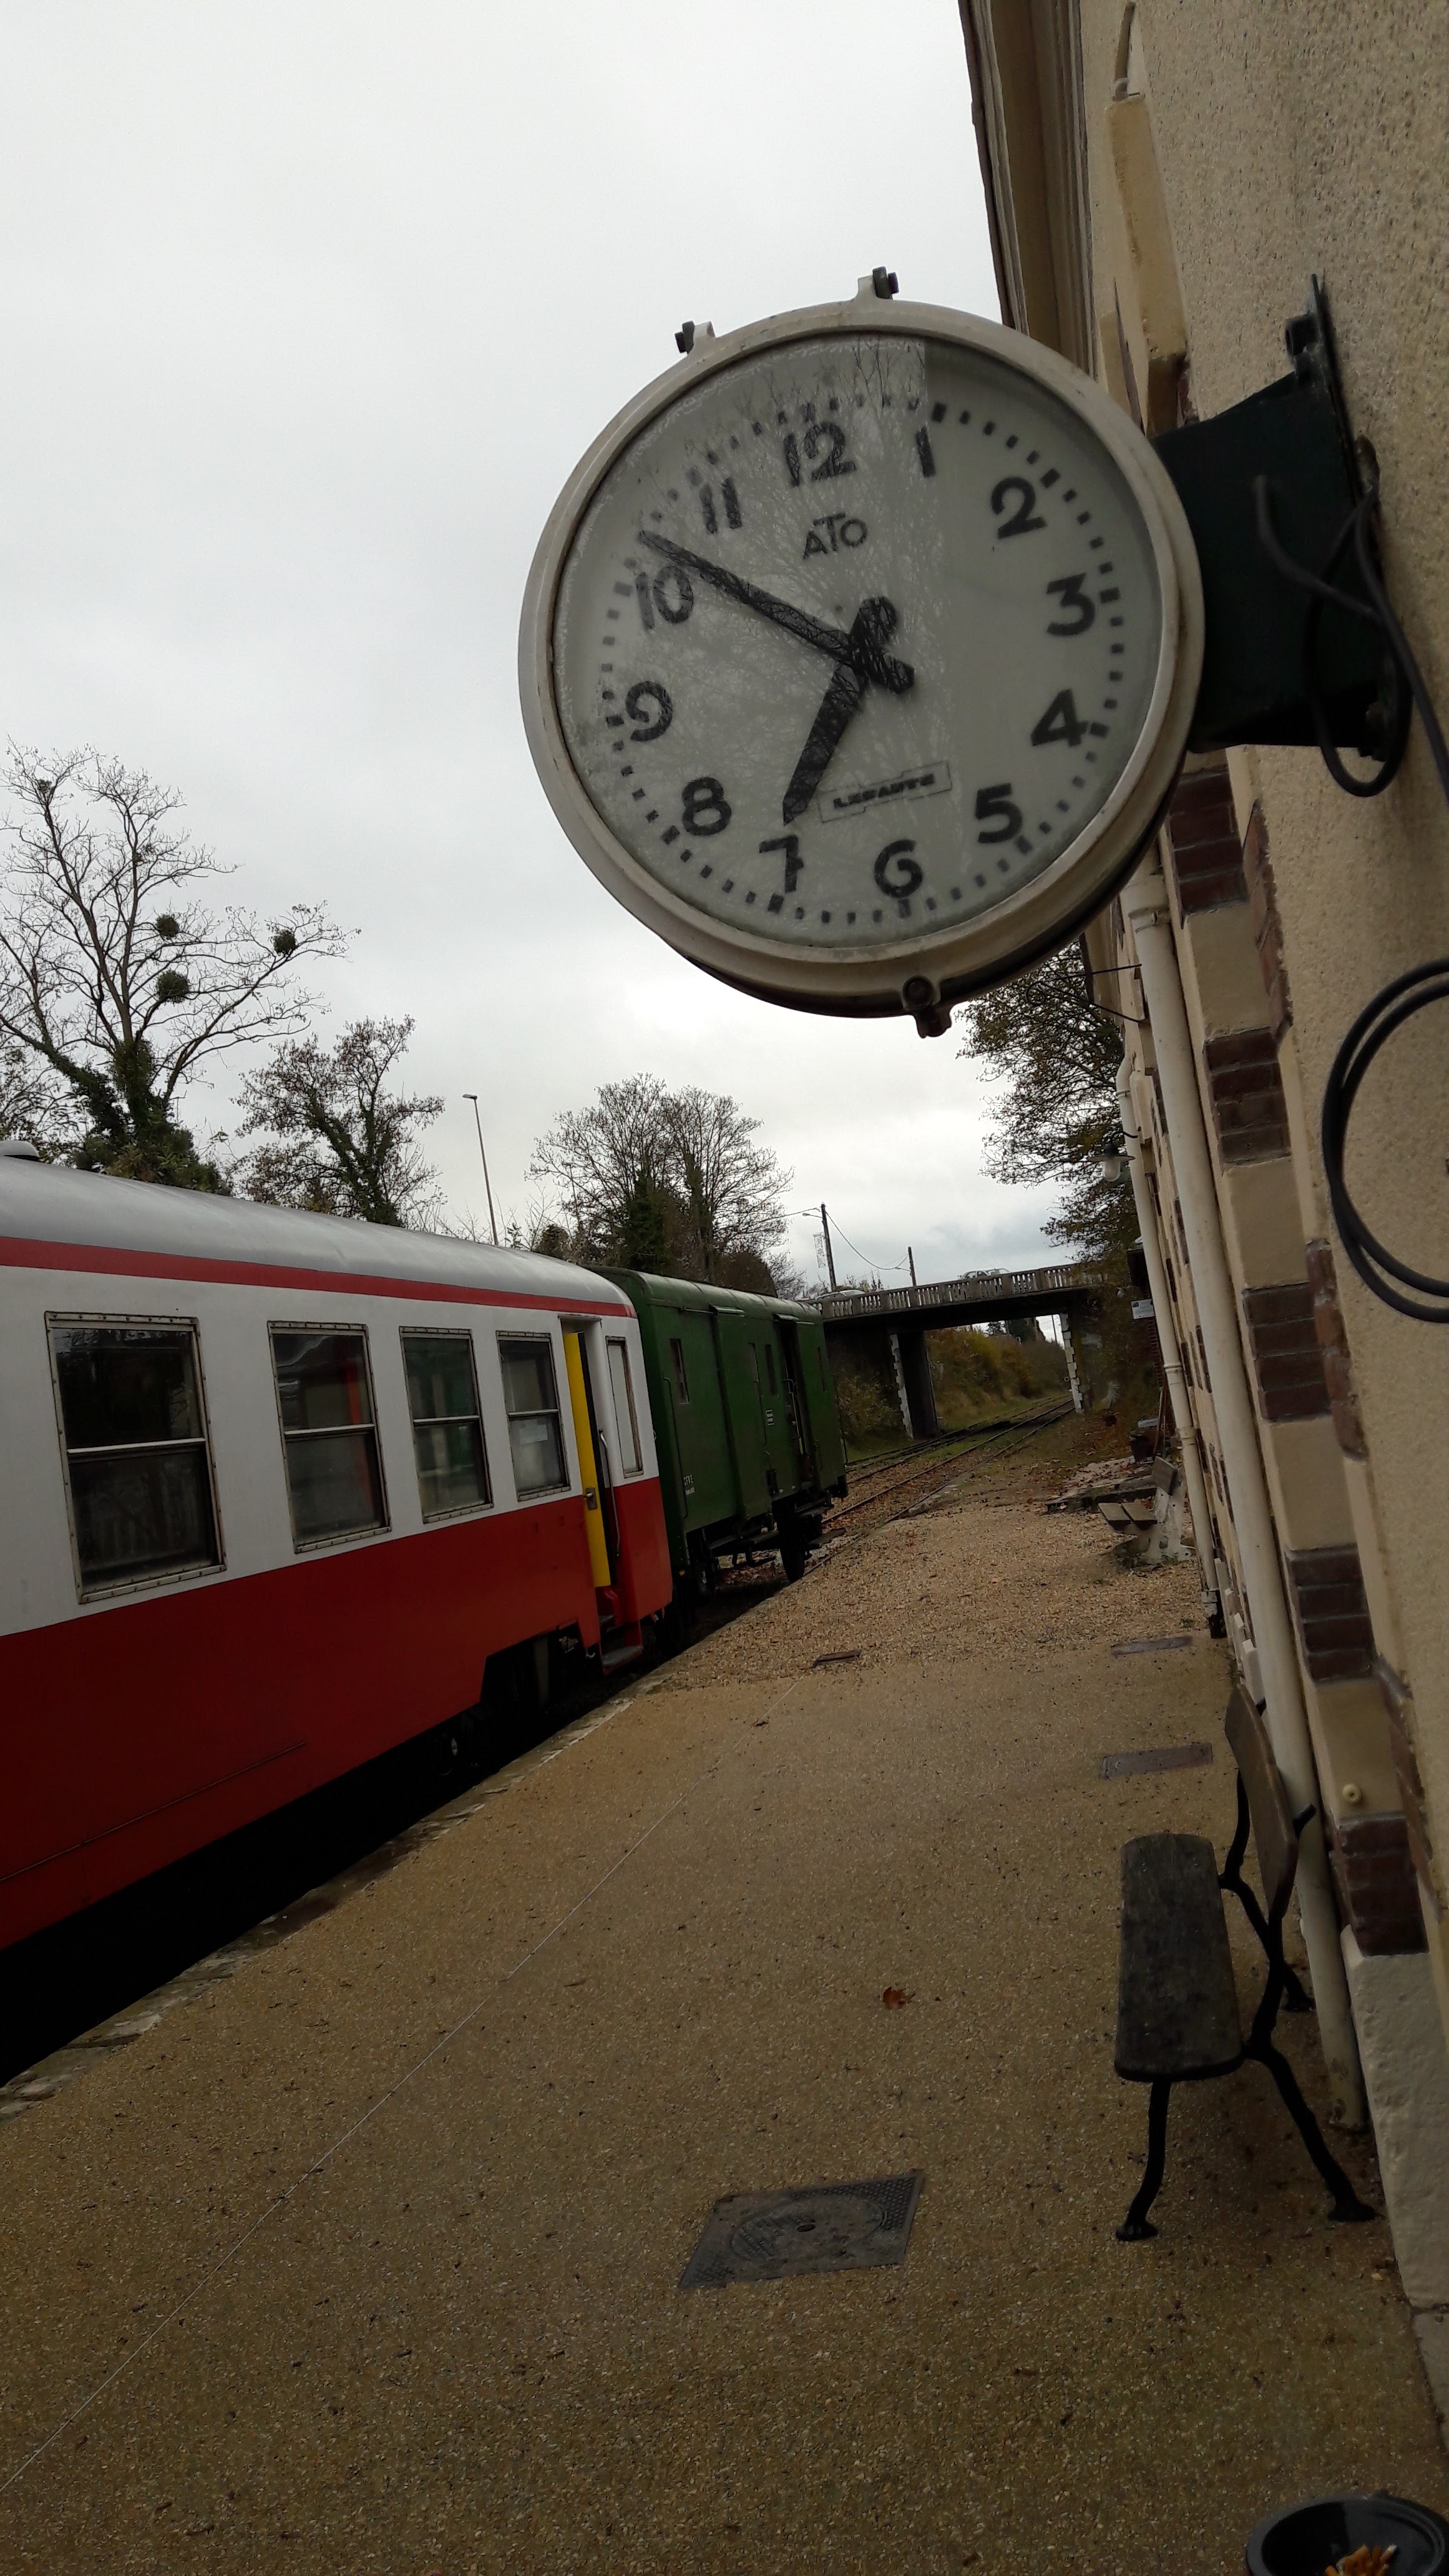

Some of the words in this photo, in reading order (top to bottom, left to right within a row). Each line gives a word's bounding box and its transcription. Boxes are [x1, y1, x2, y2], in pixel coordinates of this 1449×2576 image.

[784, 422, 857, 487] 12
[915, 425, 935, 478] 1
[698, 478, 743, 534] 11
[990, 476, 1046, 538] 2
[803, 512, 867, 560] ATO
[635, 566, 694, 630] 10
[1046, 573, 1096, 636] 3
[625, 681, 673, 741] 9
[1030, 689, 1088, 747] 4
[680, 777, 731, 836] 8
[974, 784, 1023, 844] 5
[759, 835, 804, 892] 7
[874, 840, 923, 899] 6
